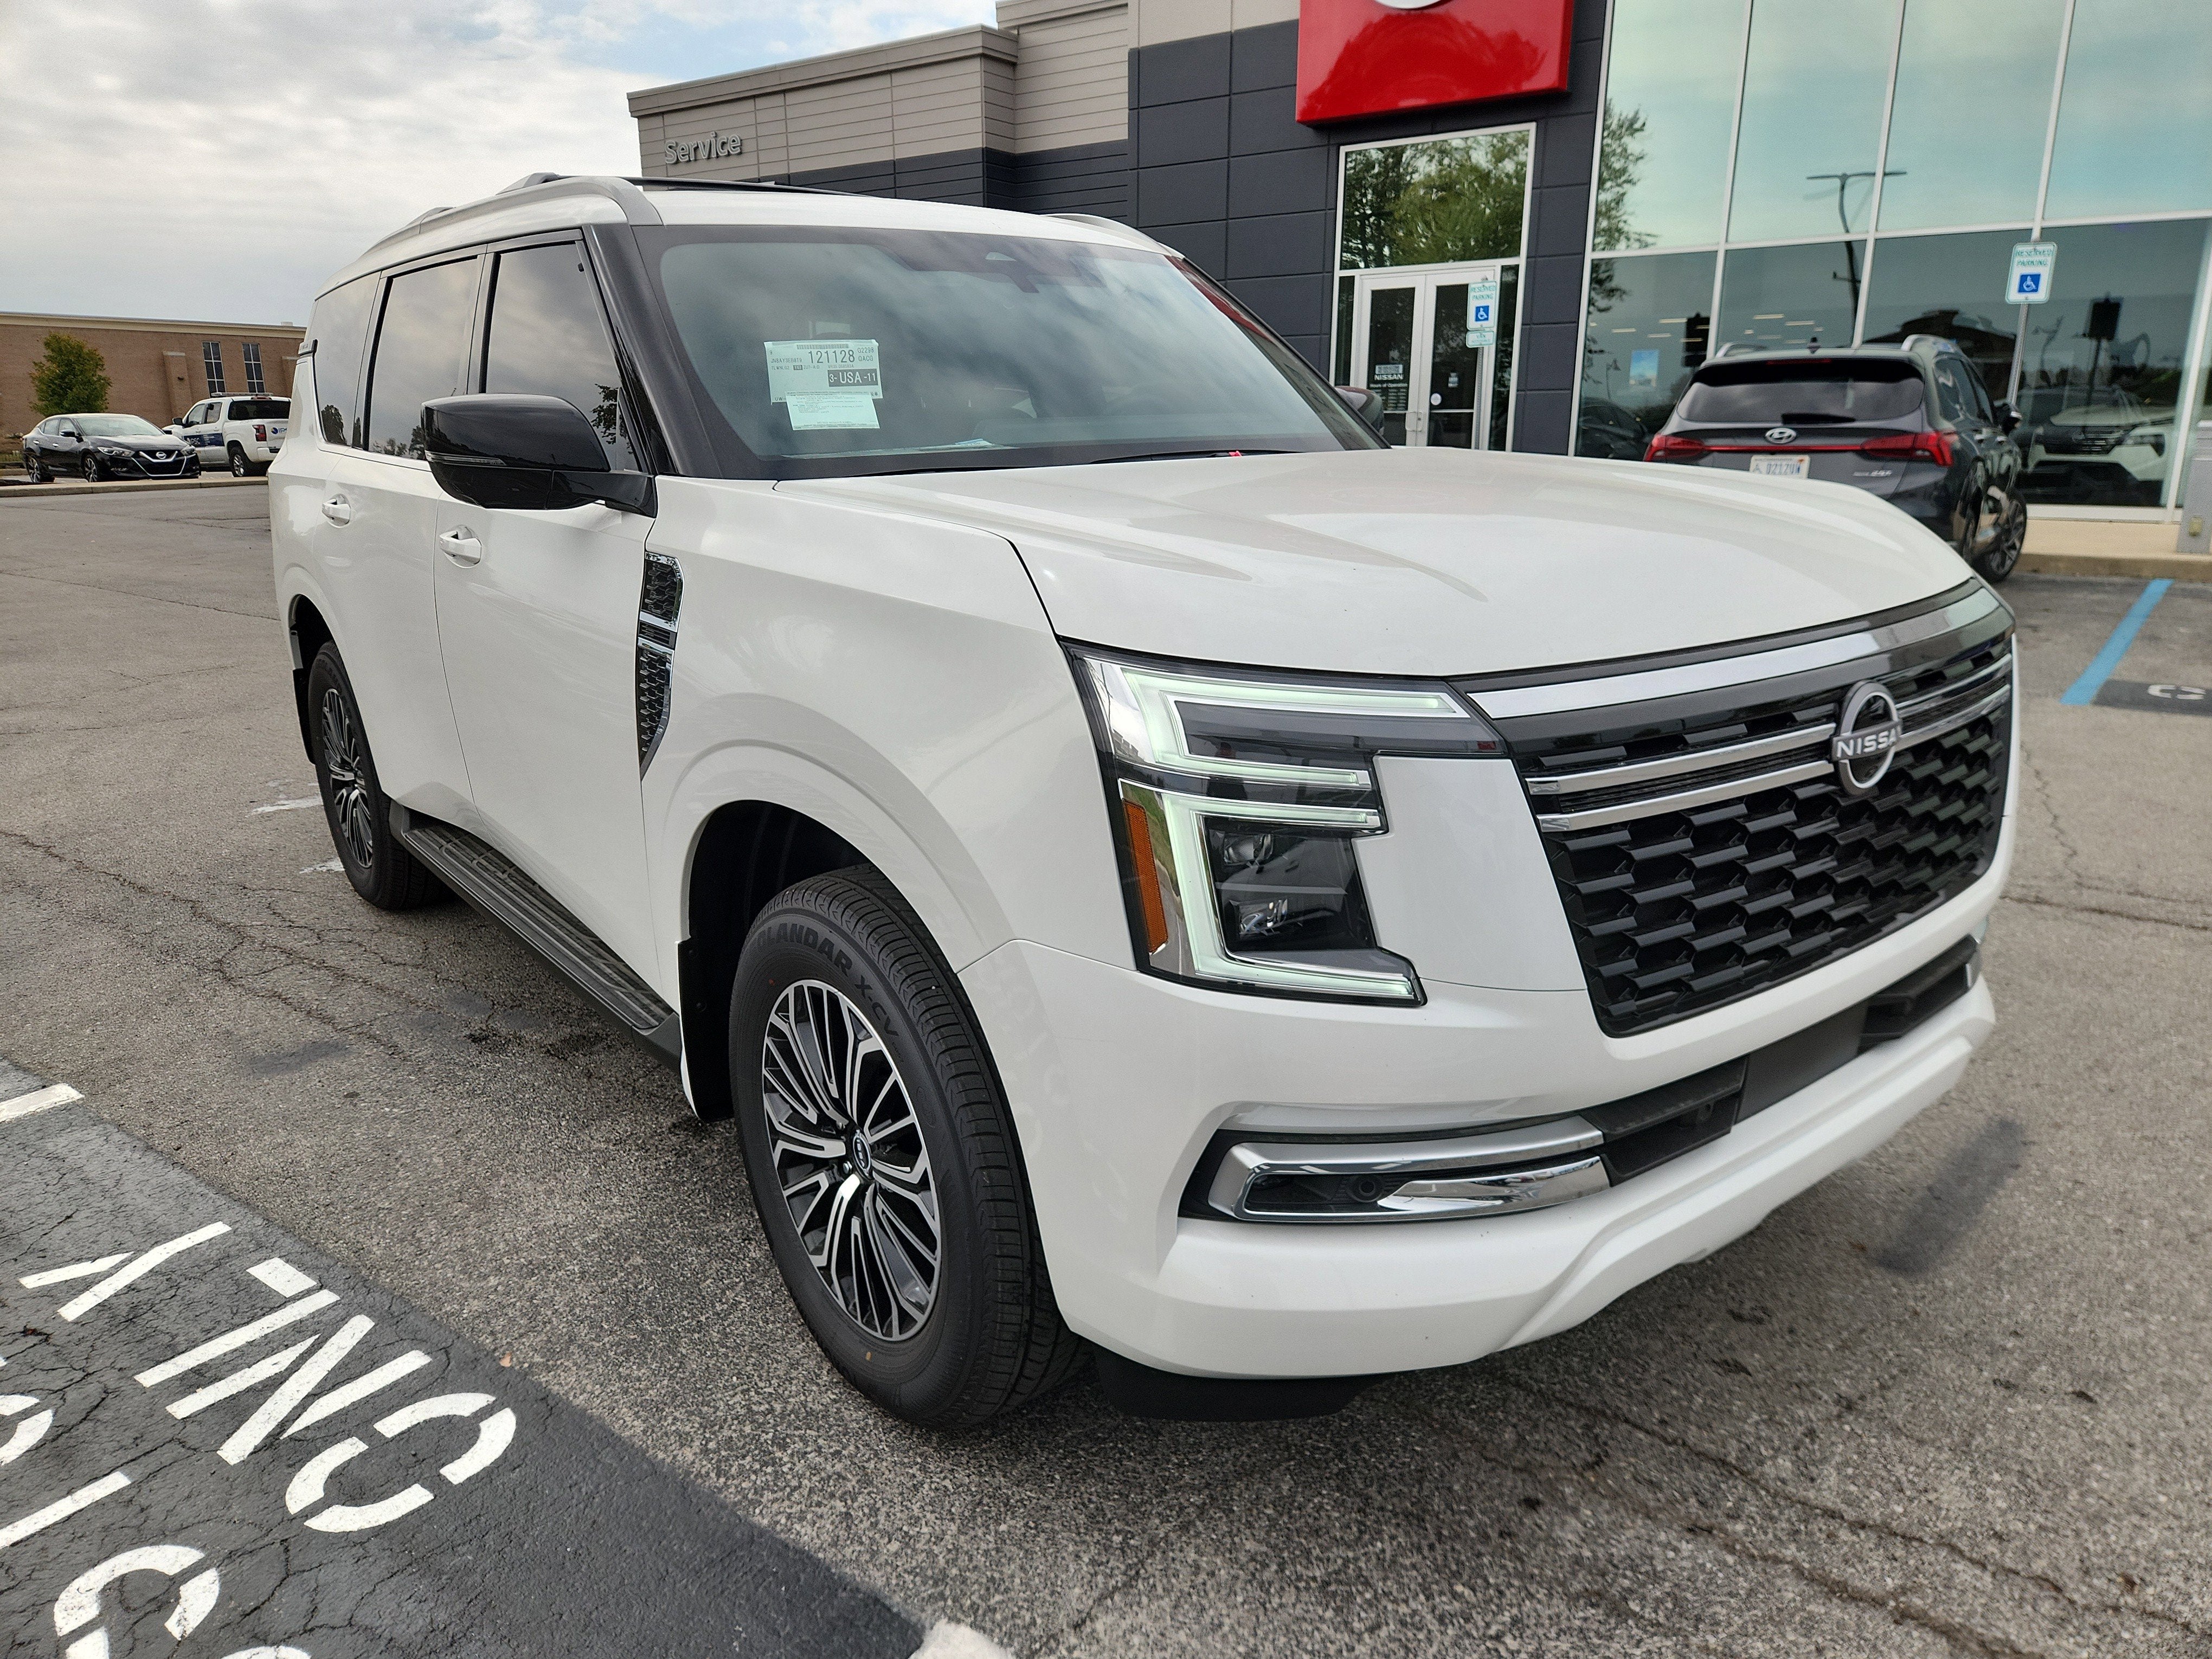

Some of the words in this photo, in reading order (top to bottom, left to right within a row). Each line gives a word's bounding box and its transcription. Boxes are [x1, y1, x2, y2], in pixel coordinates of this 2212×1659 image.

[665, 131, 741, 164] Service
[808, 349, 855, 364] 121128
[839, 371, 862, 383] USA
[864, 372, 876, 382] -11
[1837, 726, 1901, 758] NISSA
[855, 976, 899, 1036] X-CV
[18, 1220, 517, 1533] ONLY
